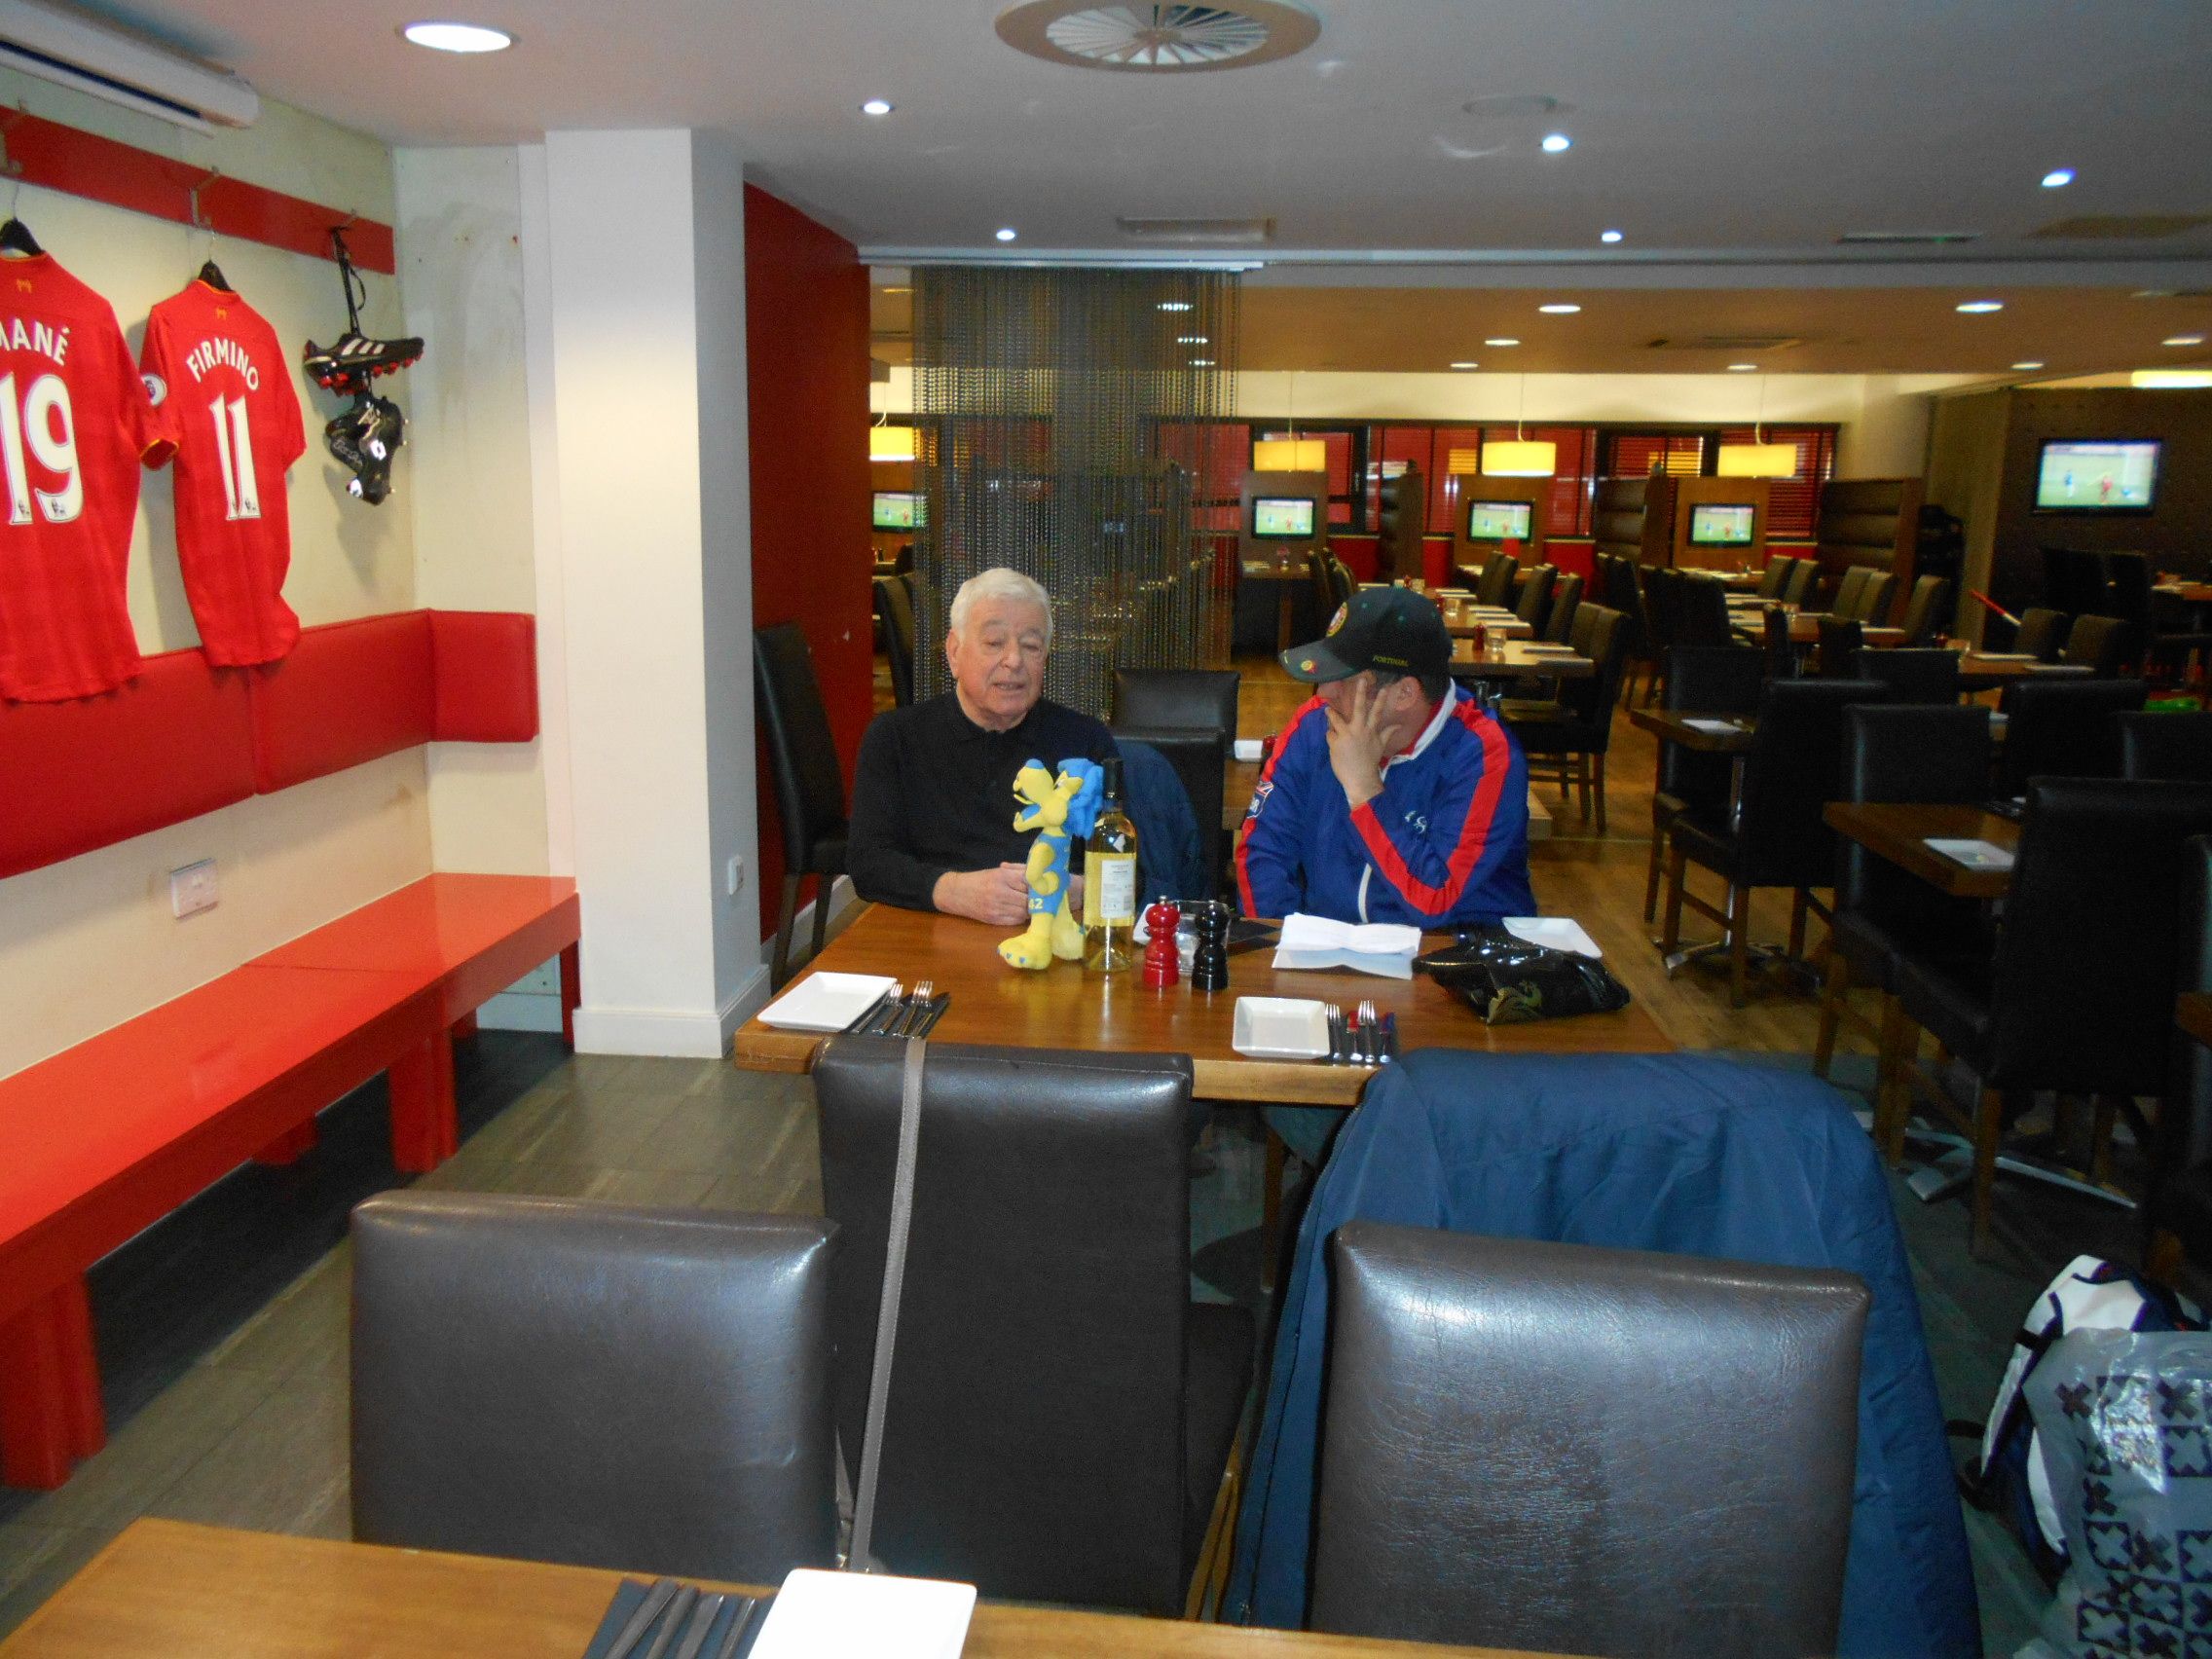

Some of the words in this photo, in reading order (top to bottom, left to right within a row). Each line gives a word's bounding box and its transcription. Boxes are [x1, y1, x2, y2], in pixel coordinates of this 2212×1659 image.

[186, 337, 260, 391] FIRMINO
[0, 371, 85, 526] 19
[208, 391, 262, 521] 11
